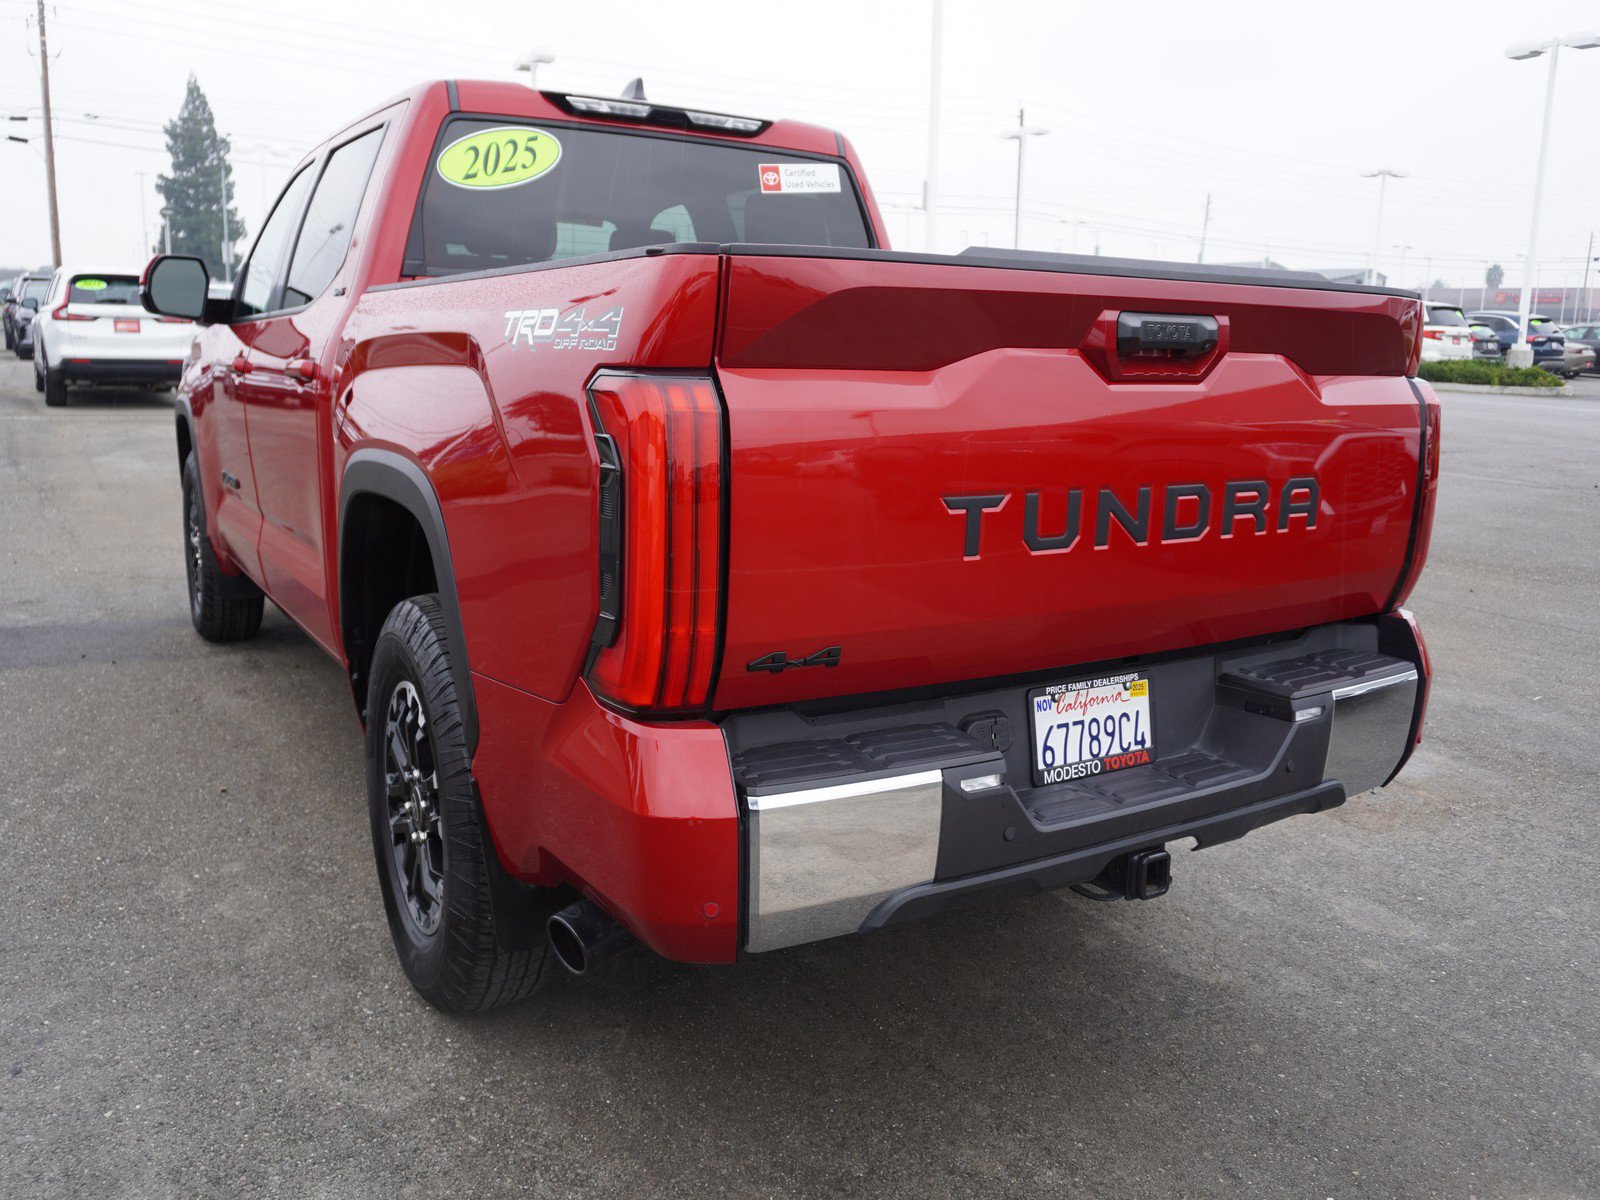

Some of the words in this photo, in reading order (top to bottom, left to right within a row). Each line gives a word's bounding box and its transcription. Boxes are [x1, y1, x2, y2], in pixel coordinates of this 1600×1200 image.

[462, 135, 538, 180] 2025
[784, 168, 816, 177] Certified
[785, 179, 804, 188] Used
[805, 179, 835, 188] Vehicles
[504, 309, 559, 350] TRD
[1146, 324, 1193, 340] TOYOTA
[578, 339, 616, 351] ROAD
[940, 476, 1321, 561] TUNDRA
[1046, 683, 1066, 694] PRICE
[1068, 680, 1092, 692] FAMILY
[1093, 673, 1139, 688] DEALERSHIPS
[1036, 698, 1052, 712] NOV
[1056, 690, 1130, 716] California
[1042, 710, 1146, 768] 67789C4
[1044, 760, 1101, 784] MODESTO
[1103, 752, 1150, 771] TOYOTA
